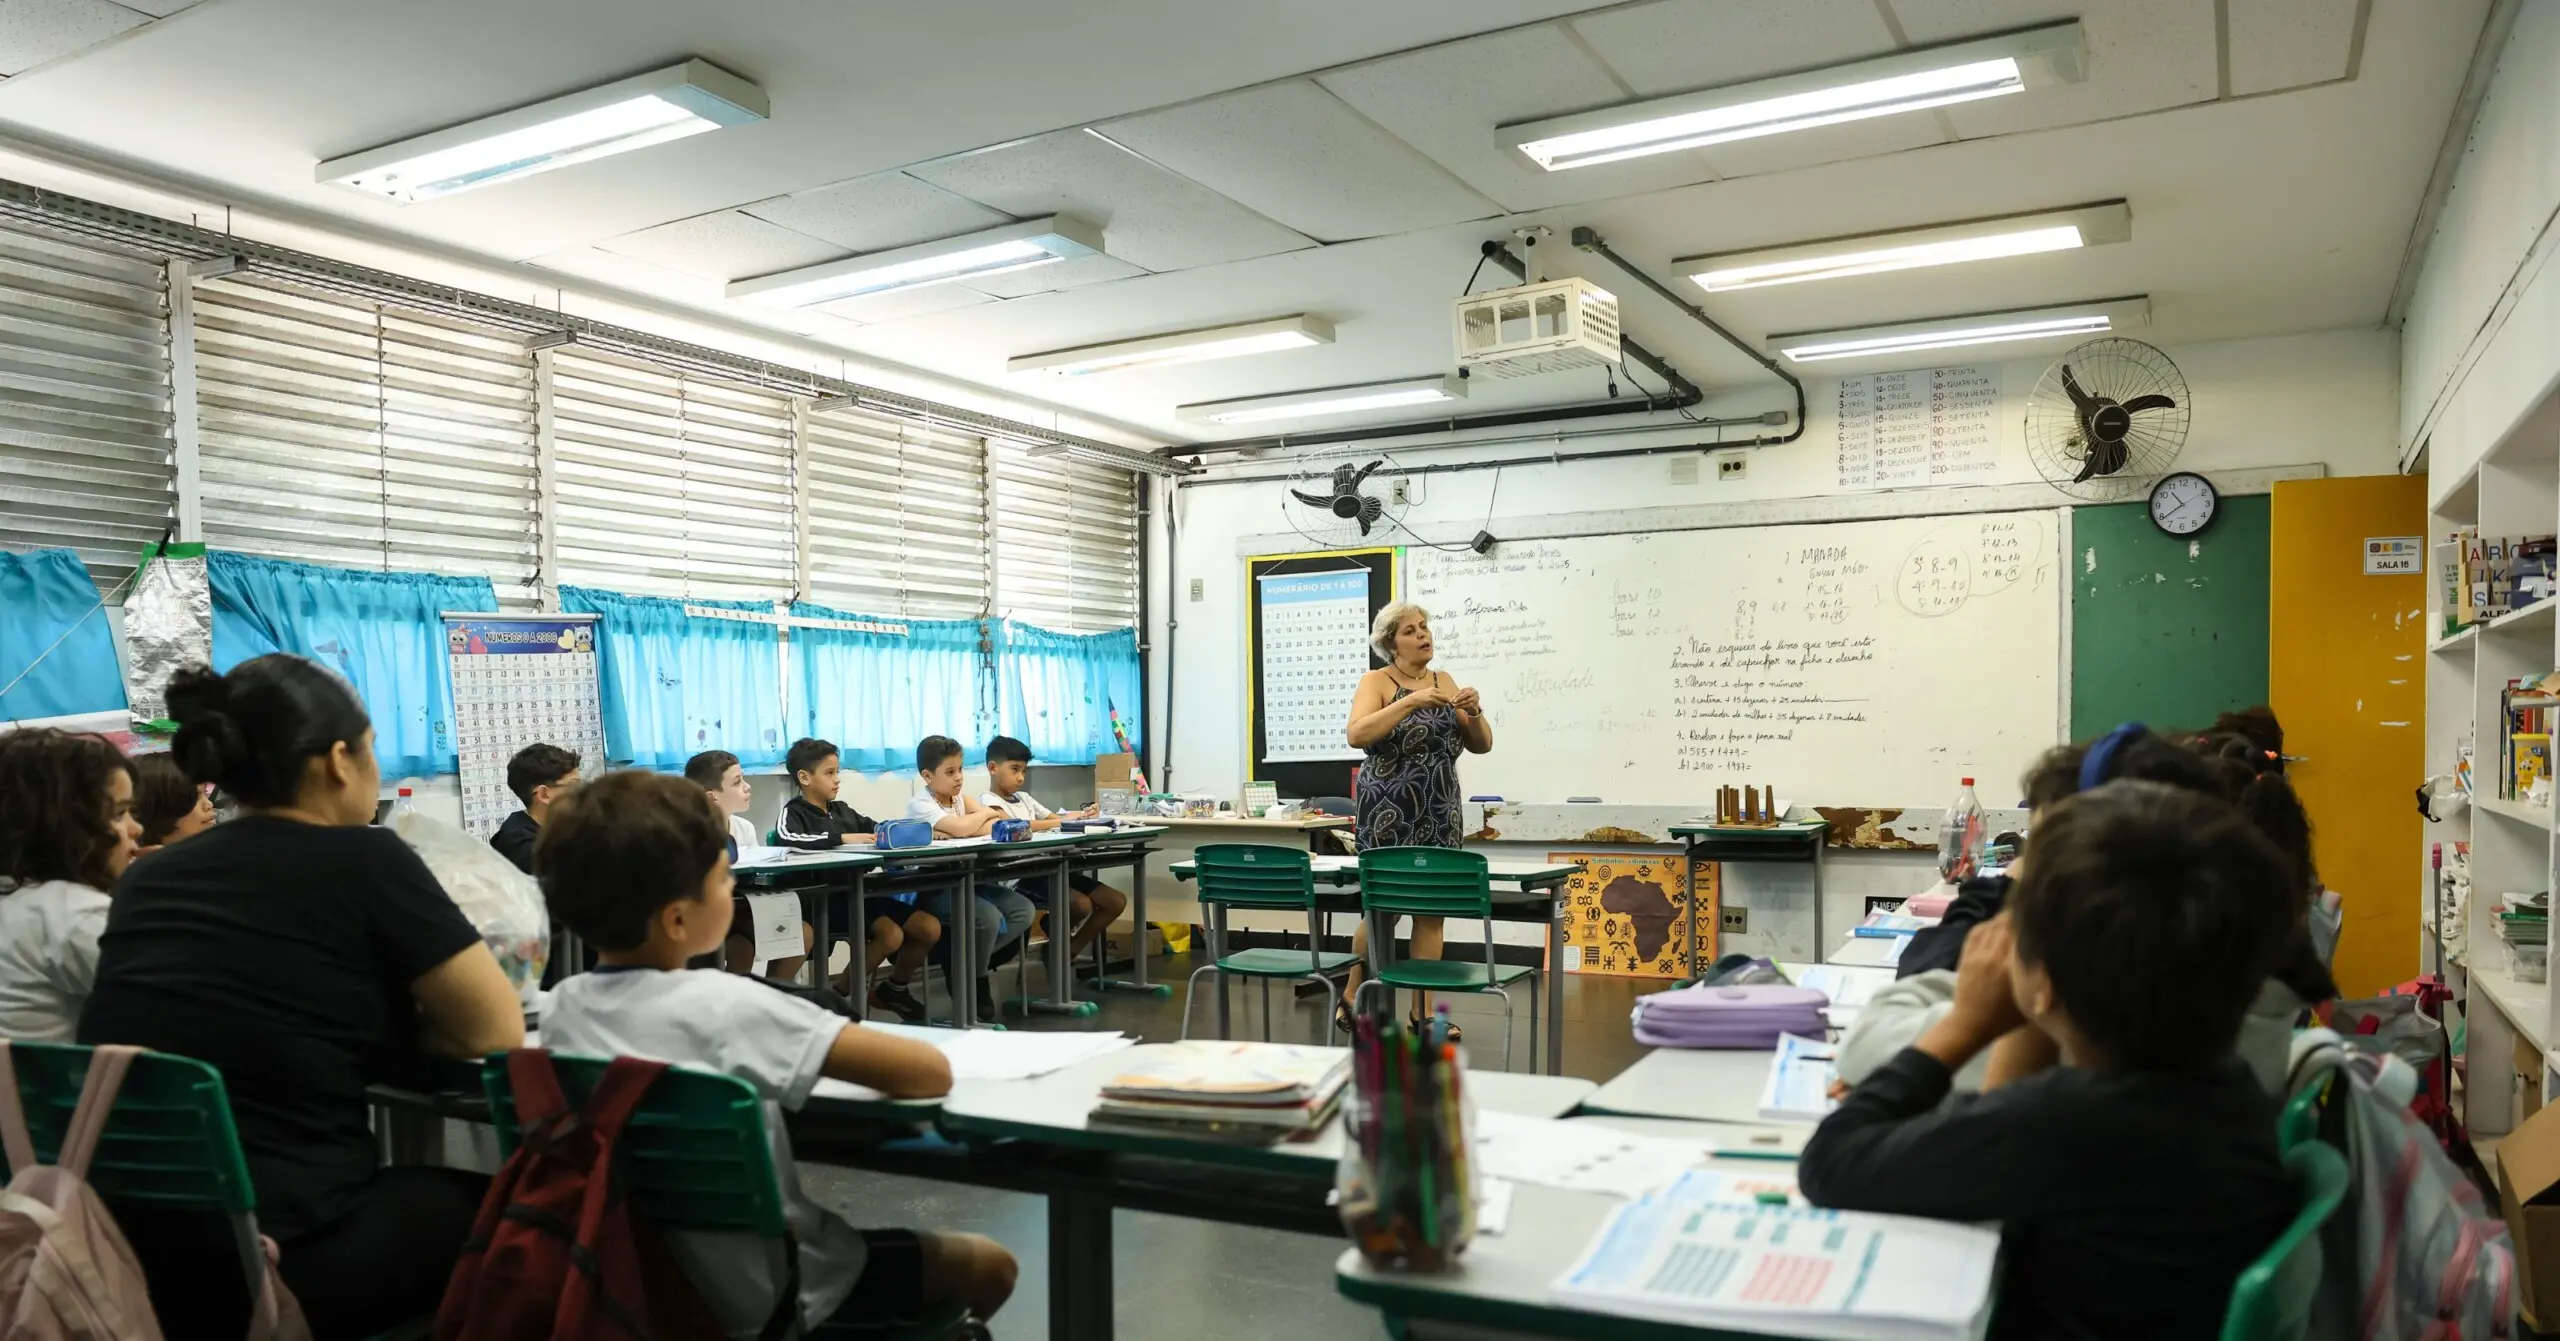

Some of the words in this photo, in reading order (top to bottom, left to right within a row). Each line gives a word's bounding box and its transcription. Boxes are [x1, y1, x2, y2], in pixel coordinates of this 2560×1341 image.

[2179, 479, 2188, 487] 12
[2205, 500, 2210, 508] 3
[2470, 548, 2481, 562] A
[2376, 561, 2399, 569] SALA
[2401, 560, 2409, 569] 16
[2493, 569, 2505, 582] K
[1267, 581, 1319, 595] NUMERÁRIO
[1320, 583, 1331, 591] DE
[1340, 581, 1347, 589] A
[1348, 579, 1363, 589] 100
[2474, 592, 2487, 608] S
[484, 630, 522, 644] NÚMEROS
[530, 632, 537, 643] A
[537, 632, 558, 644] 2000
[1688, 634, 1711, 655] Não
[1716, 643, 1755, 662] esquecer
[1776, 637, 1799, 651] livro
[1803, 641, 1821, 657] que
[1825, 638, 1849, 649] você
[1669, 657, 1705, 669] levando
[1708, 660, 1716, 668] e
[1720, 656, 1732, 668] de
[1785, 658, 1796, 666] na
[1800, 653, 1822, 672] ficha
[1835, 649, 1873, 663] desenho
[1685, 673, 1717, 688] Observe
[1732, 708, 1741, 718] de
[1776, 728, 1793, 740] real
